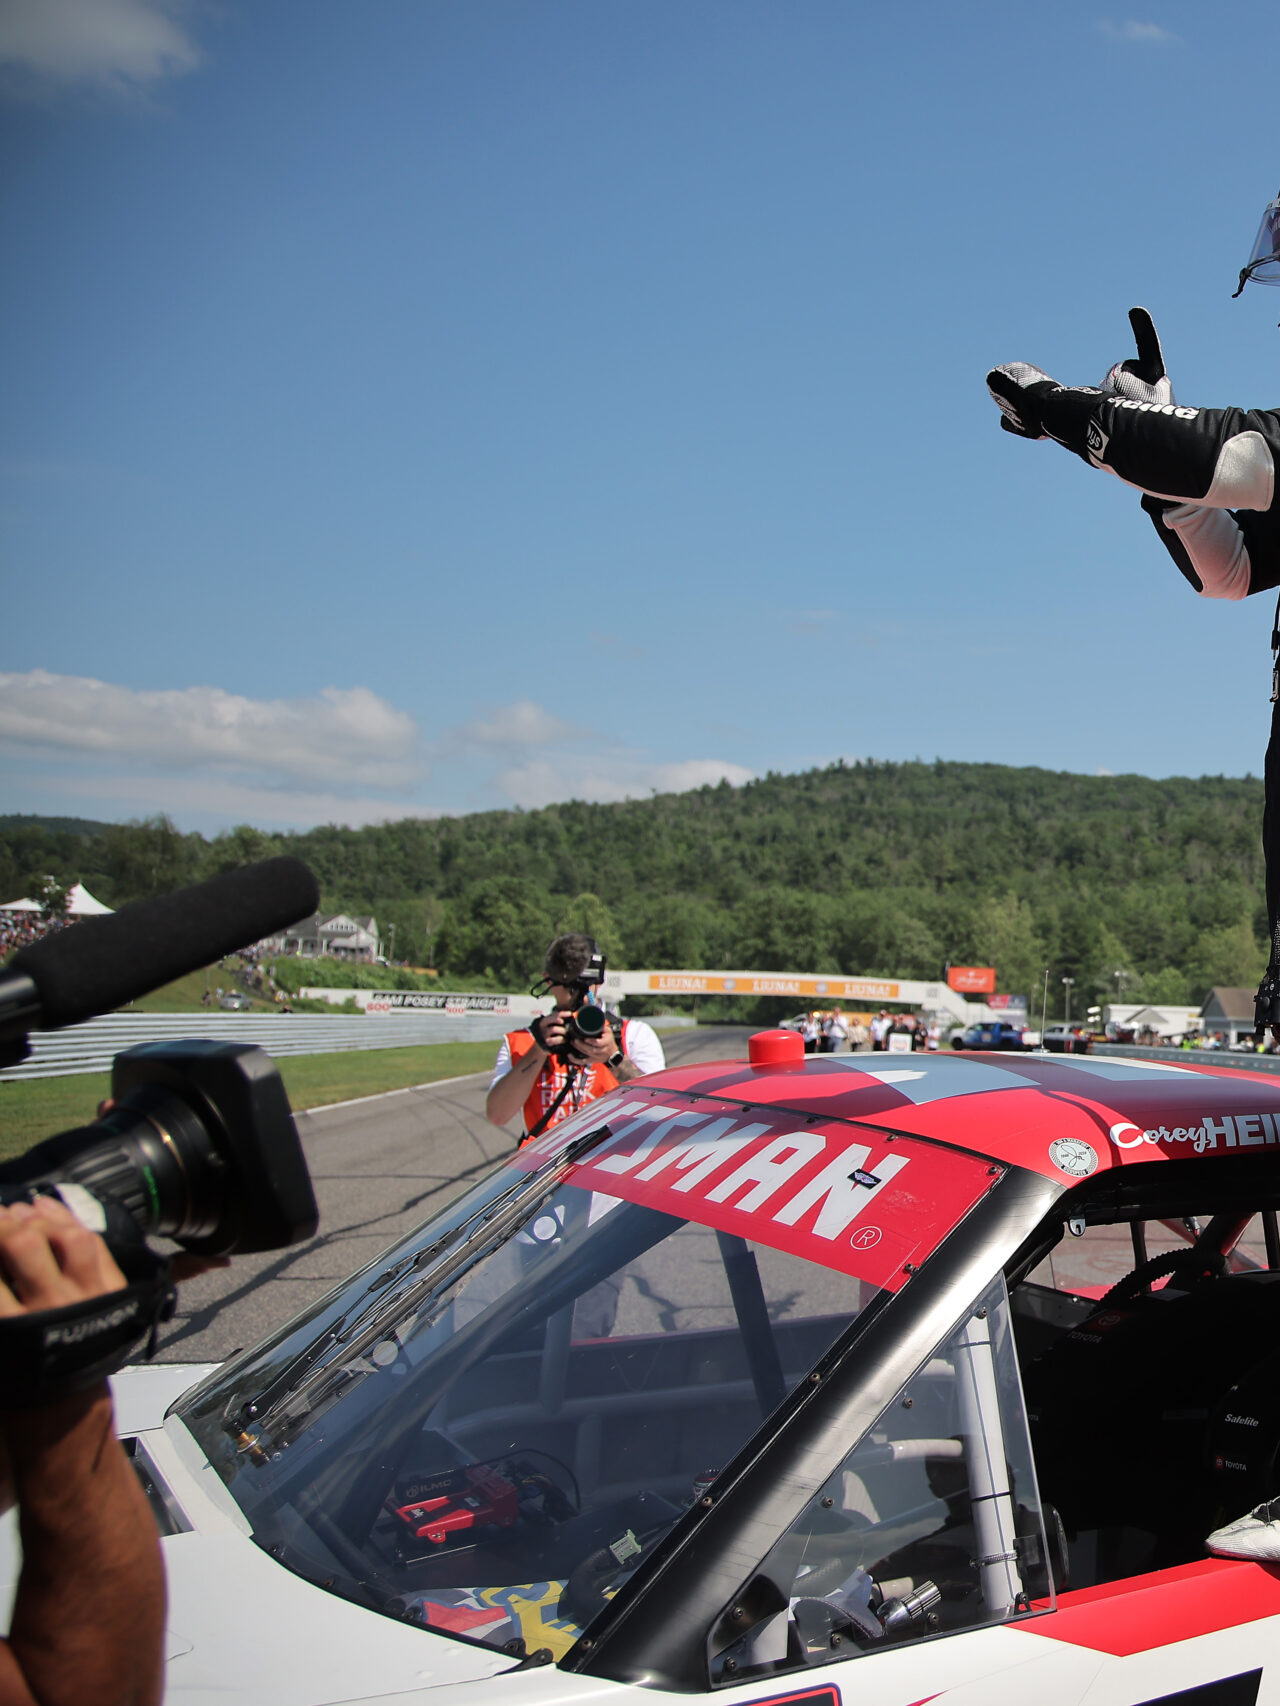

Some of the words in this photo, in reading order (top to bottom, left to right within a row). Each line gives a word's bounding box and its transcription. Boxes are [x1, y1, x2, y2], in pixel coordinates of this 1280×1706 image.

[403, 996, 445, 1008] POSEY
[445, 998, 507, 1010] STRAIGHT
[541, 1089, 596, 1105] ROK
[1110, 1122, 1210, 1153] Corey
[529, 1097, 911, 1241] AFTSMAN
[1225, 1413, 1259, 1427] Safelite
[1225, 1460, 1247, 1471] TOYOTA
[420, 1479, 452, 1493] ILMO
